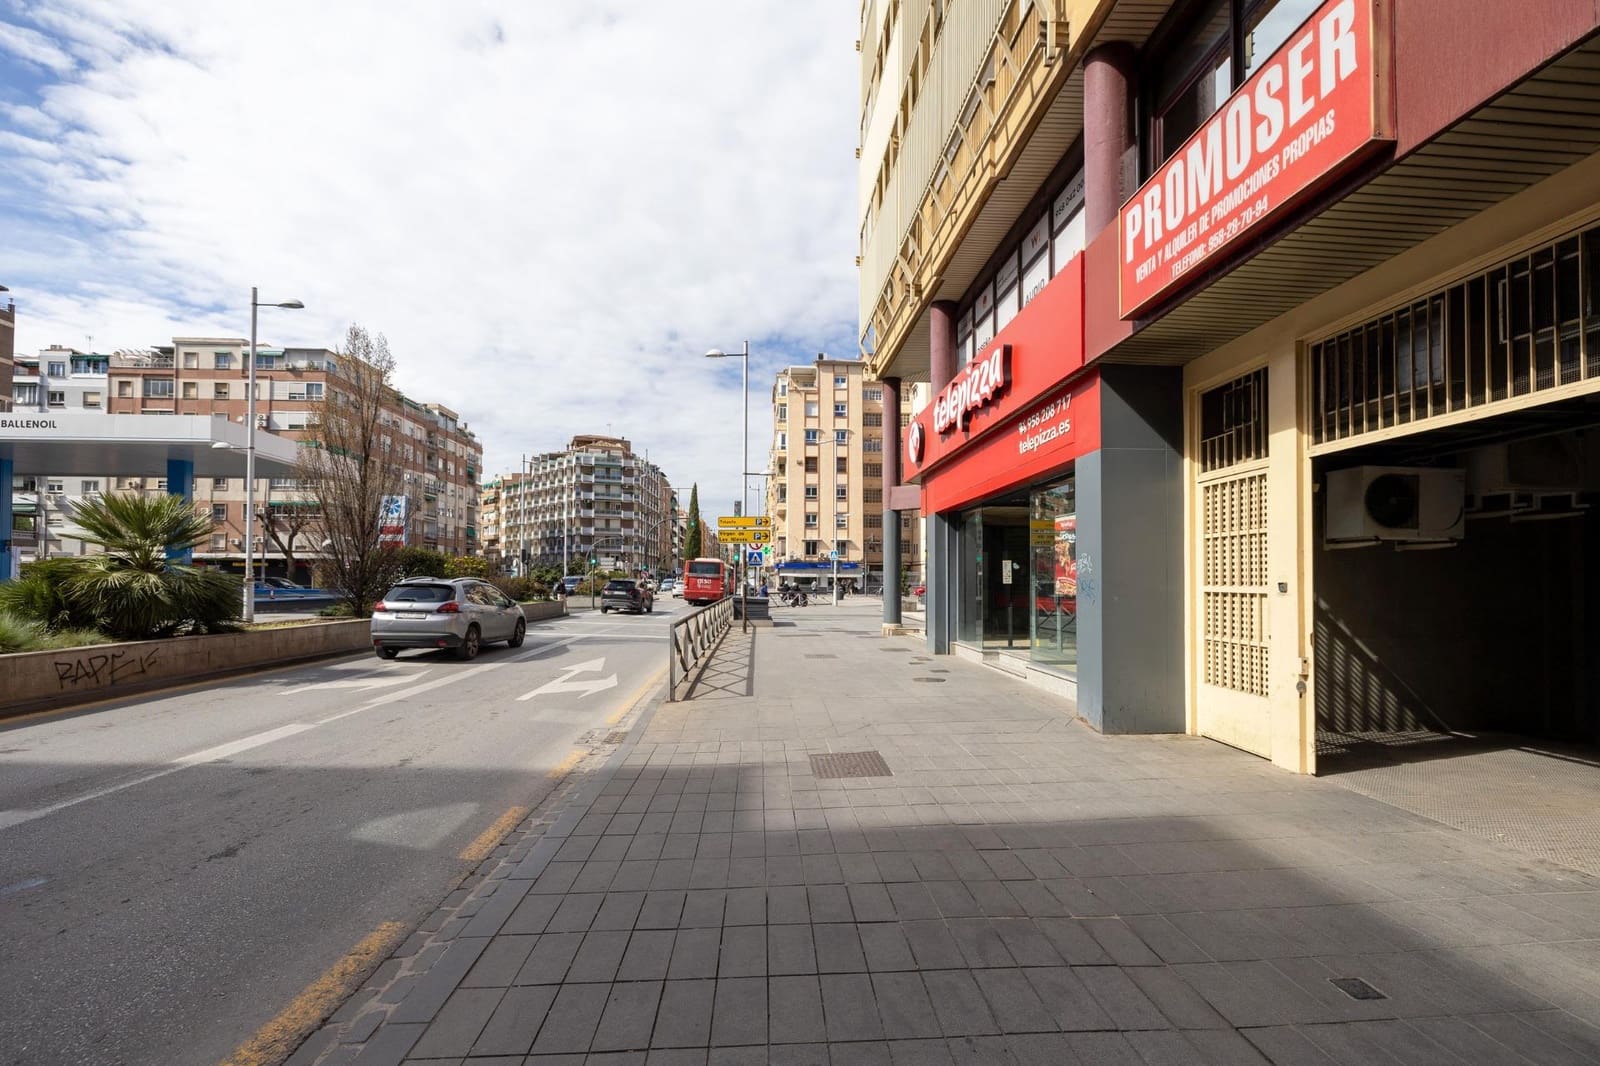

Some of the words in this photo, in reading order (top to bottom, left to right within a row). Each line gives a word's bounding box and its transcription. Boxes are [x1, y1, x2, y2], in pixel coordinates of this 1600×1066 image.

[1126, 0, 1358, 264] PROMOSER
[1135, 257, 1157, 284] VENTA
[1157, 249, 1163, 267] Y
[1164, 222, 1197, 263] ALQUILER
[1199, 211, 1210, 235] DE
[1211, 153, 1280, 226] PROMOCIONES
[1282, 108, 1335, 170] PROPIAS
[1208, 194, 1268, 251] 958-28-70-94
[933, 348, 1003, 433] telepizza
[1027, 413, 1040, 431] 958
[1041, 405, 1056, 423] 208
[1056, 393, 1072, 414] 717
[1, 420, 57, 429] BALLENOIL
[1019, 418, 1070, 454] telepizza.es
